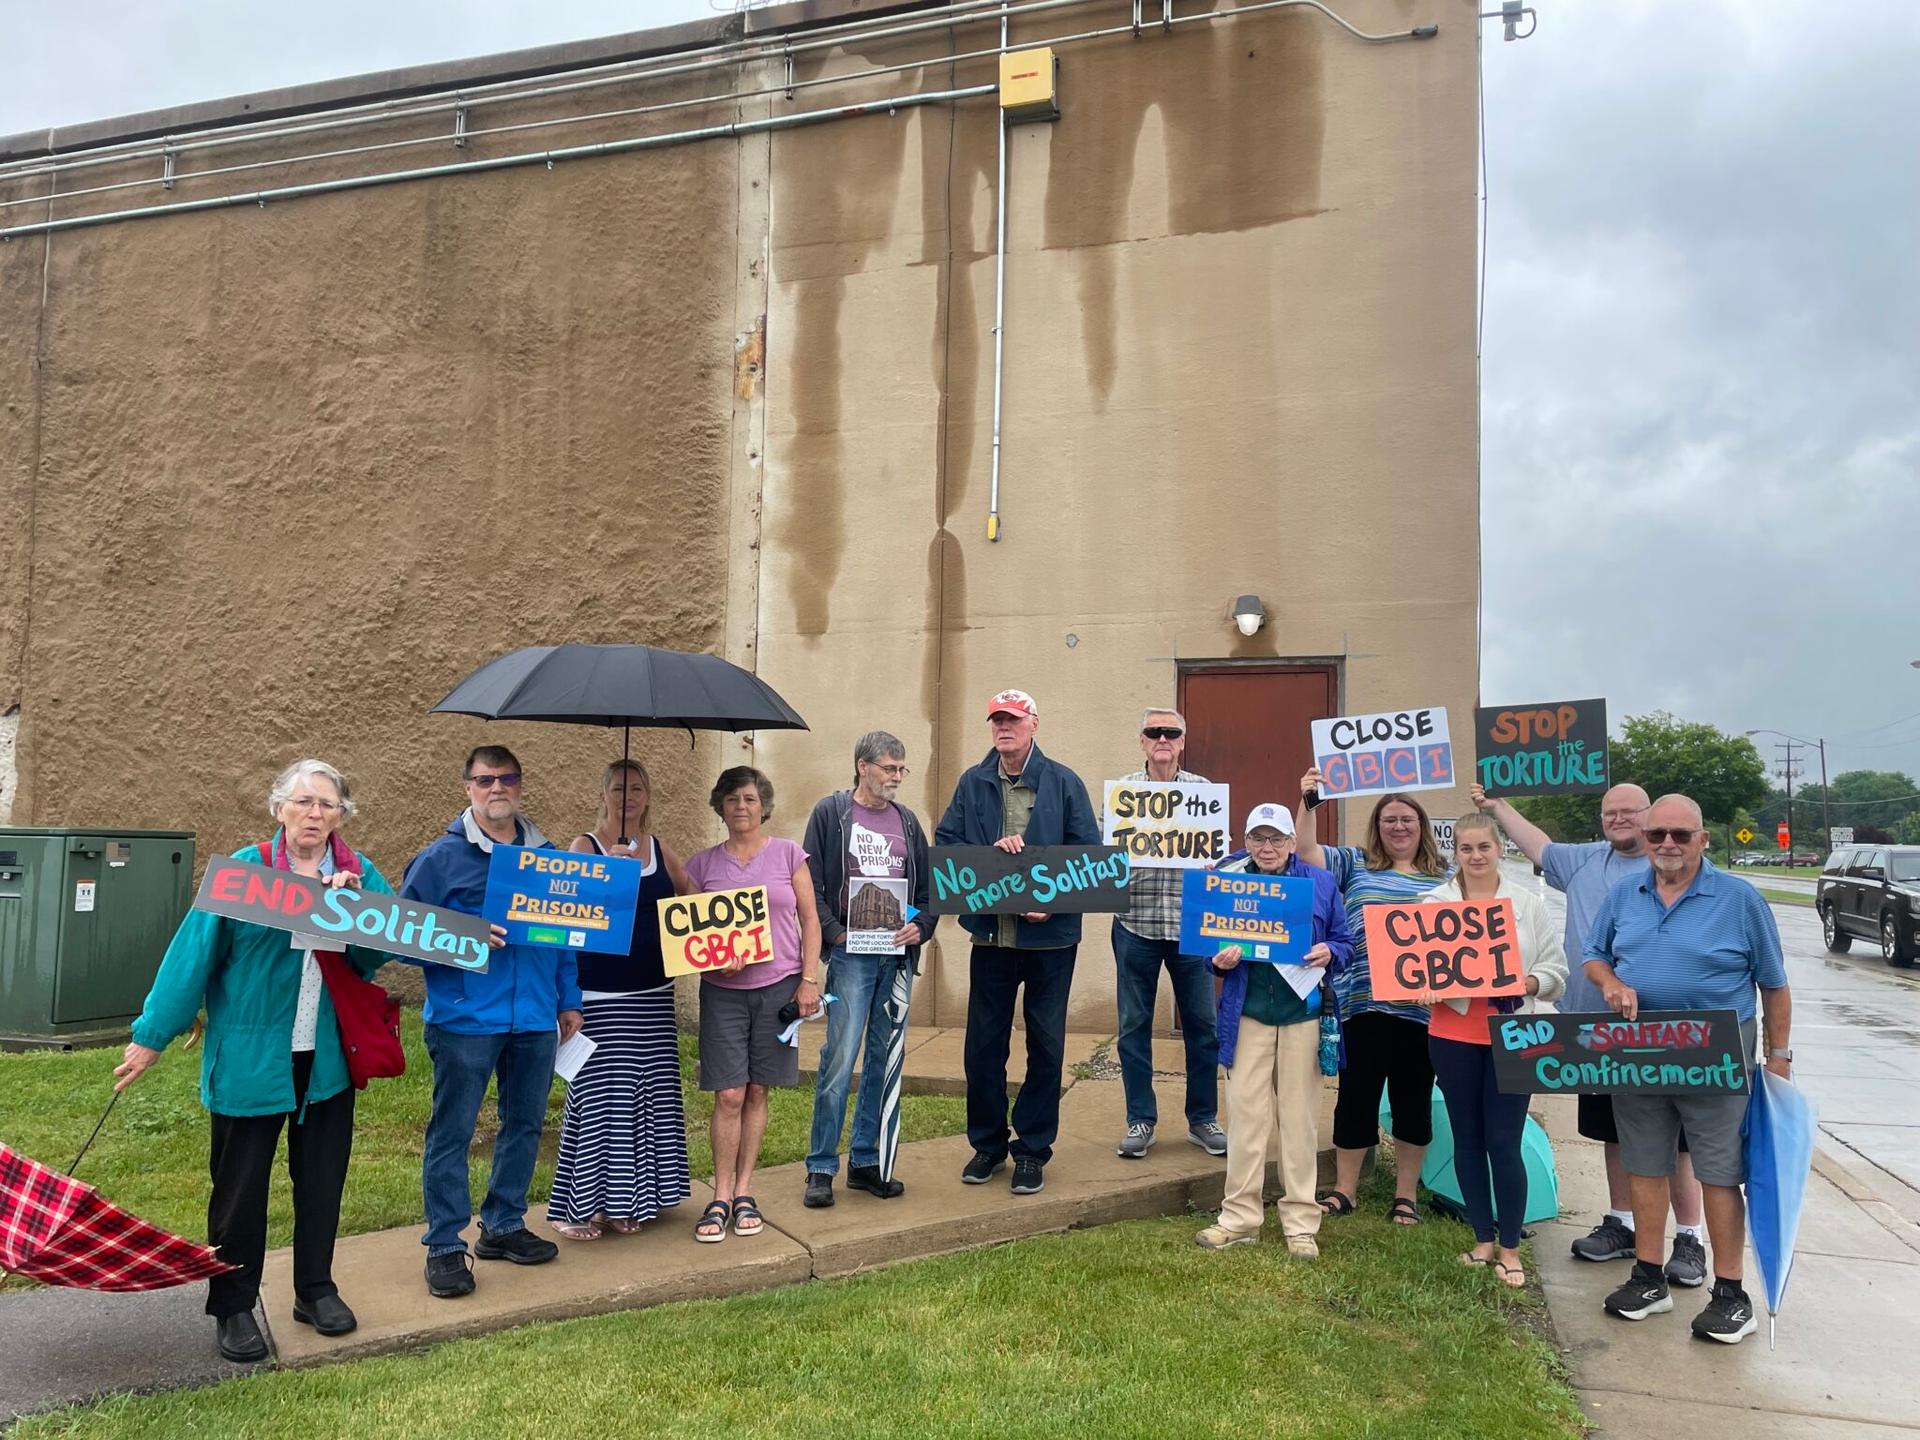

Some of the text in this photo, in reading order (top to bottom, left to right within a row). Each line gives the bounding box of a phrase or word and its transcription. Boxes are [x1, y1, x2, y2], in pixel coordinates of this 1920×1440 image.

[1330, 710, 1433, 750] CLOSE
[1490, 705, 1578, 744] STOP
[1556, 738, 1585, 756] the
[1324, 747, 1450, 793] GBCI
[1478, 750, 1606, 791] TORTURE
[1115, 790, 1222, 820] STOP the
[856, 833, 873, 843] NO
[858, 844, 883, 855] NEW
[1112, 826, 1224, 860] TORTURE
[1433, 825, 1452, 838] NO
[860, 855, 904, 868] PRISONS
[549, 878, 580, 894] NOT
[932, 851, 1130, 912] No more Solitary
[209, 867, 490, 969] END Solitary
[664, 889, 766, 937] CLOSE
[1233, 898, 1260, 911] NOT
[1385, 904, 1506, 947] CLOSE
[684, 925, 771, 969] GBCI
[1394, 943, 1518, 991] GBCI
[1500, 1019, 1712, 1052] END SOLITARY
[1535, 1052, 1744, 1090] Confinement
